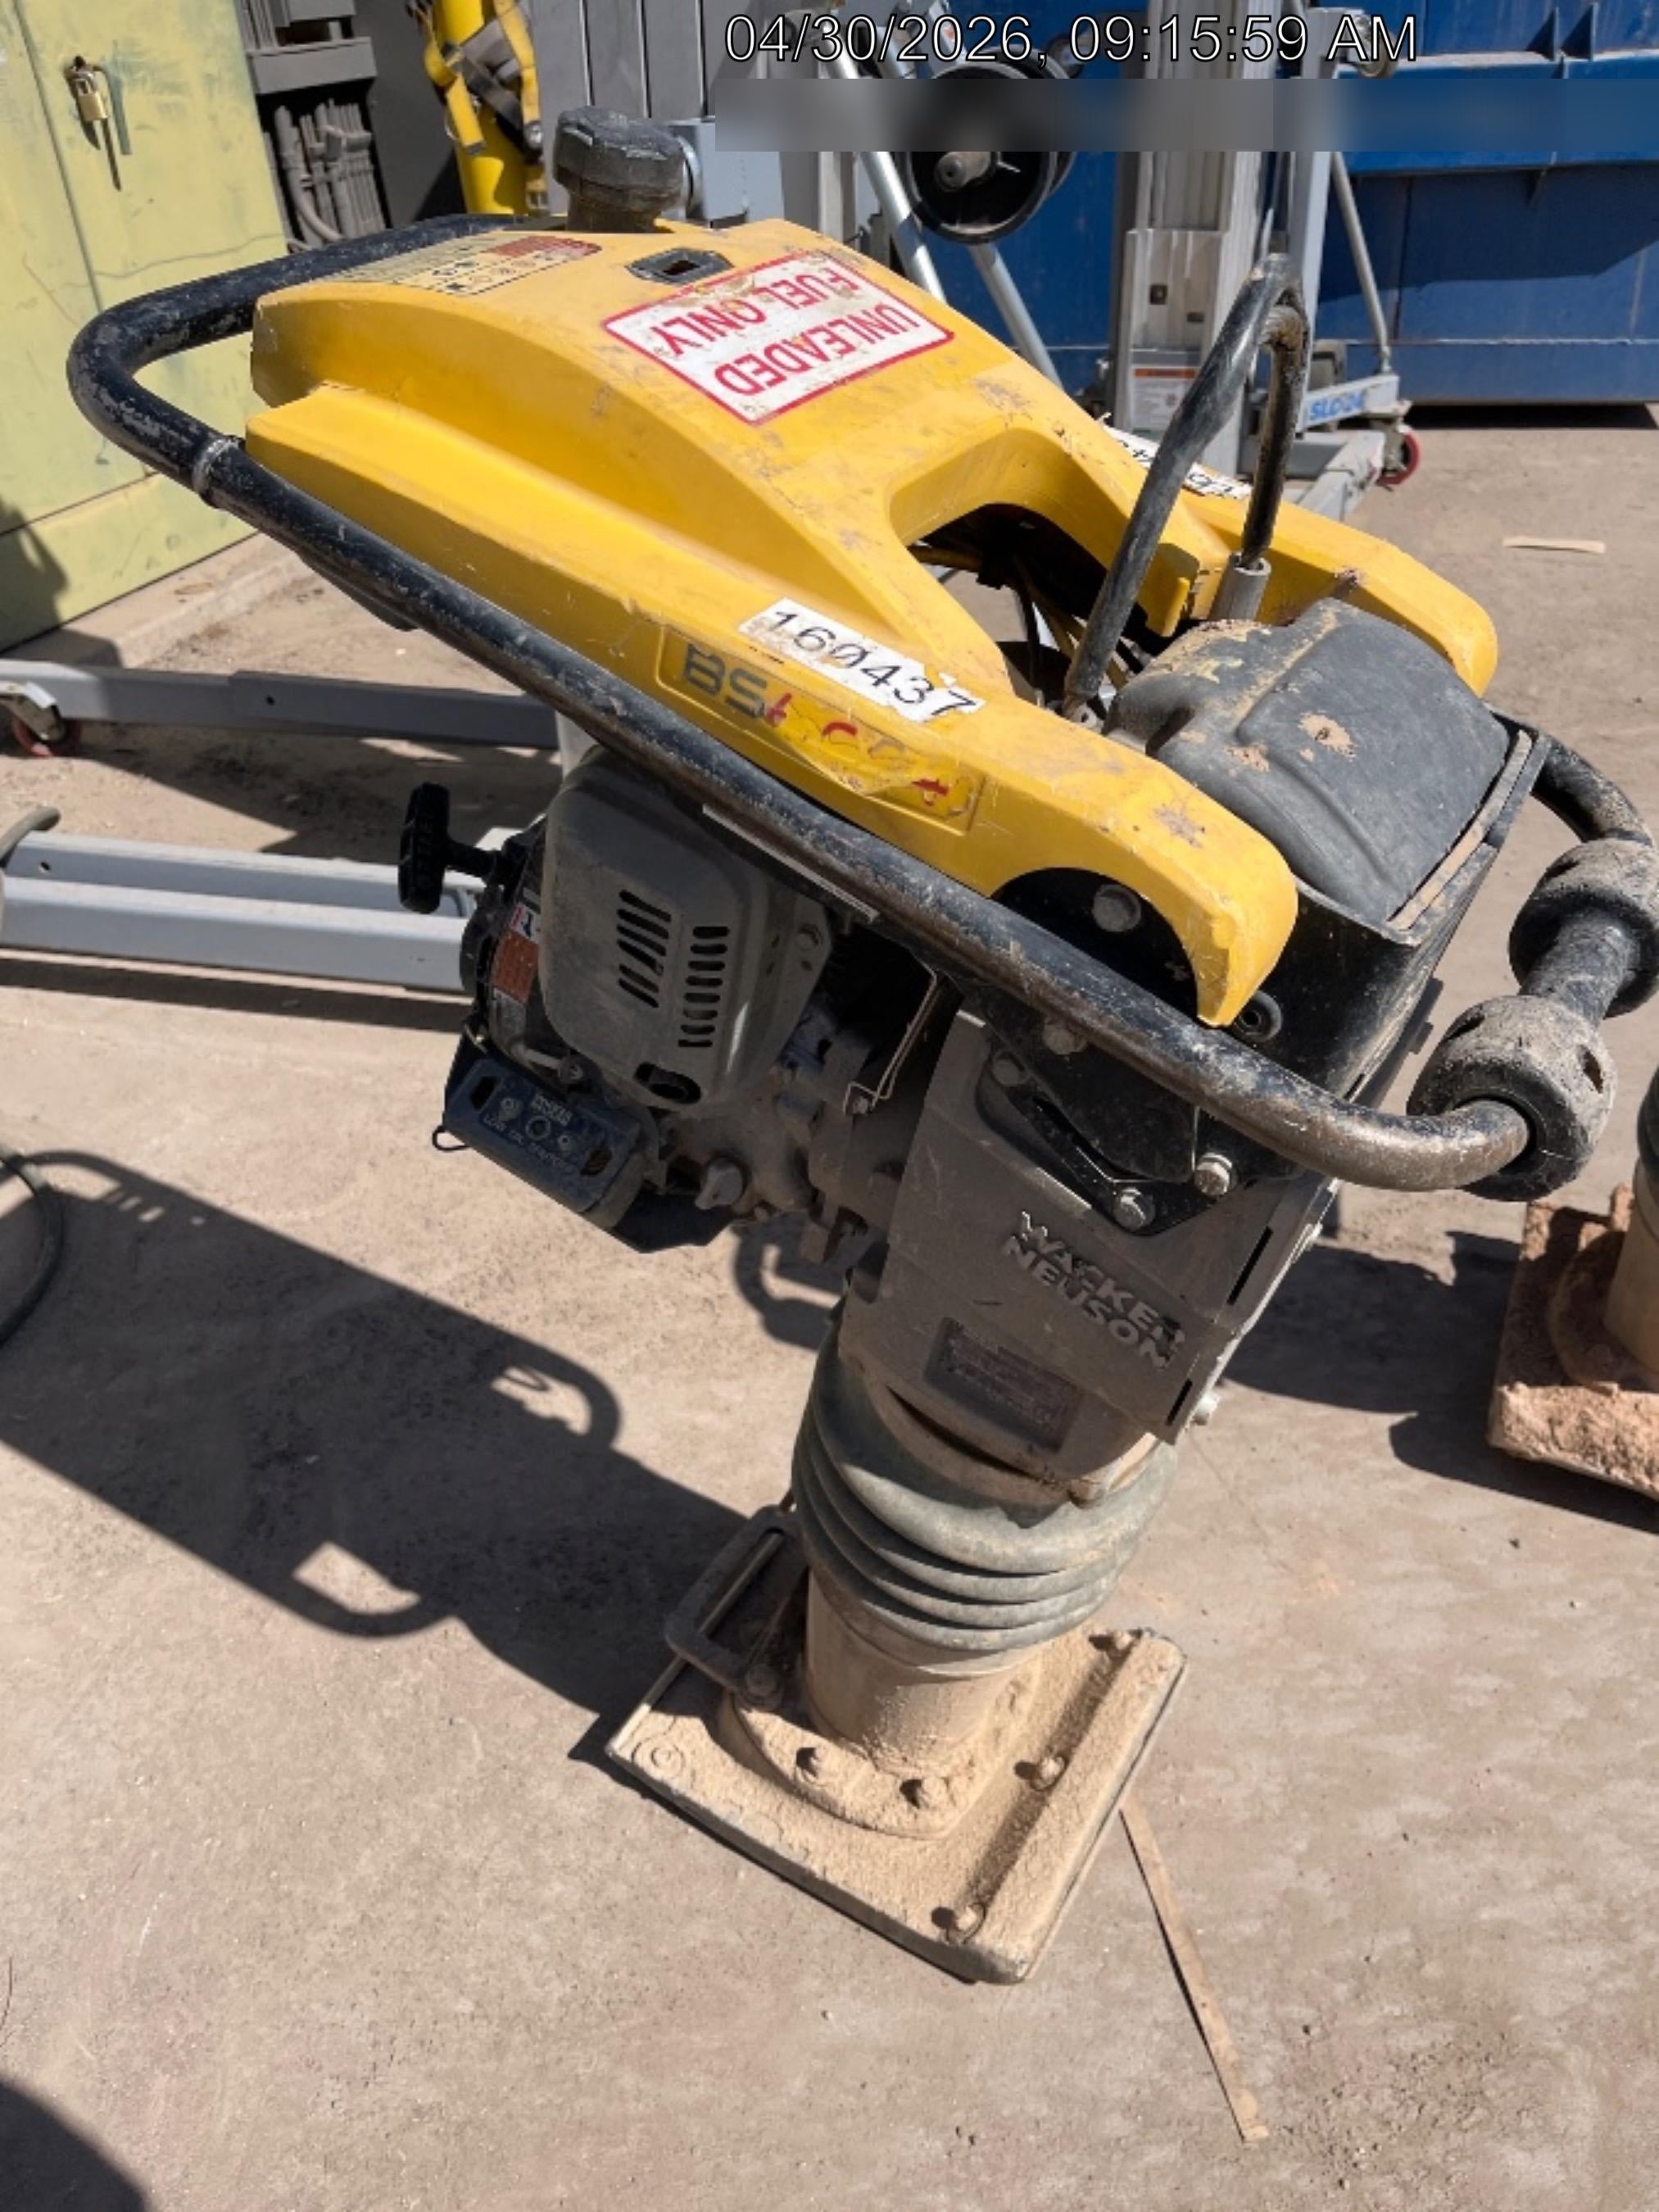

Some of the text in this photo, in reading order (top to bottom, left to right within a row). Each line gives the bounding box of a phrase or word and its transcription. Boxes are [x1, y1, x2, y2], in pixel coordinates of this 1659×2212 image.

[651, 267, 859, 356] FUEL ONLY
[714, 304, 921, 397] UNLEADED
[767, 610, 977, 717] 160437
[1004, 1235, 1170, 1370] NEUSON
[1021, 1211, 1186, 1353] WACKER
